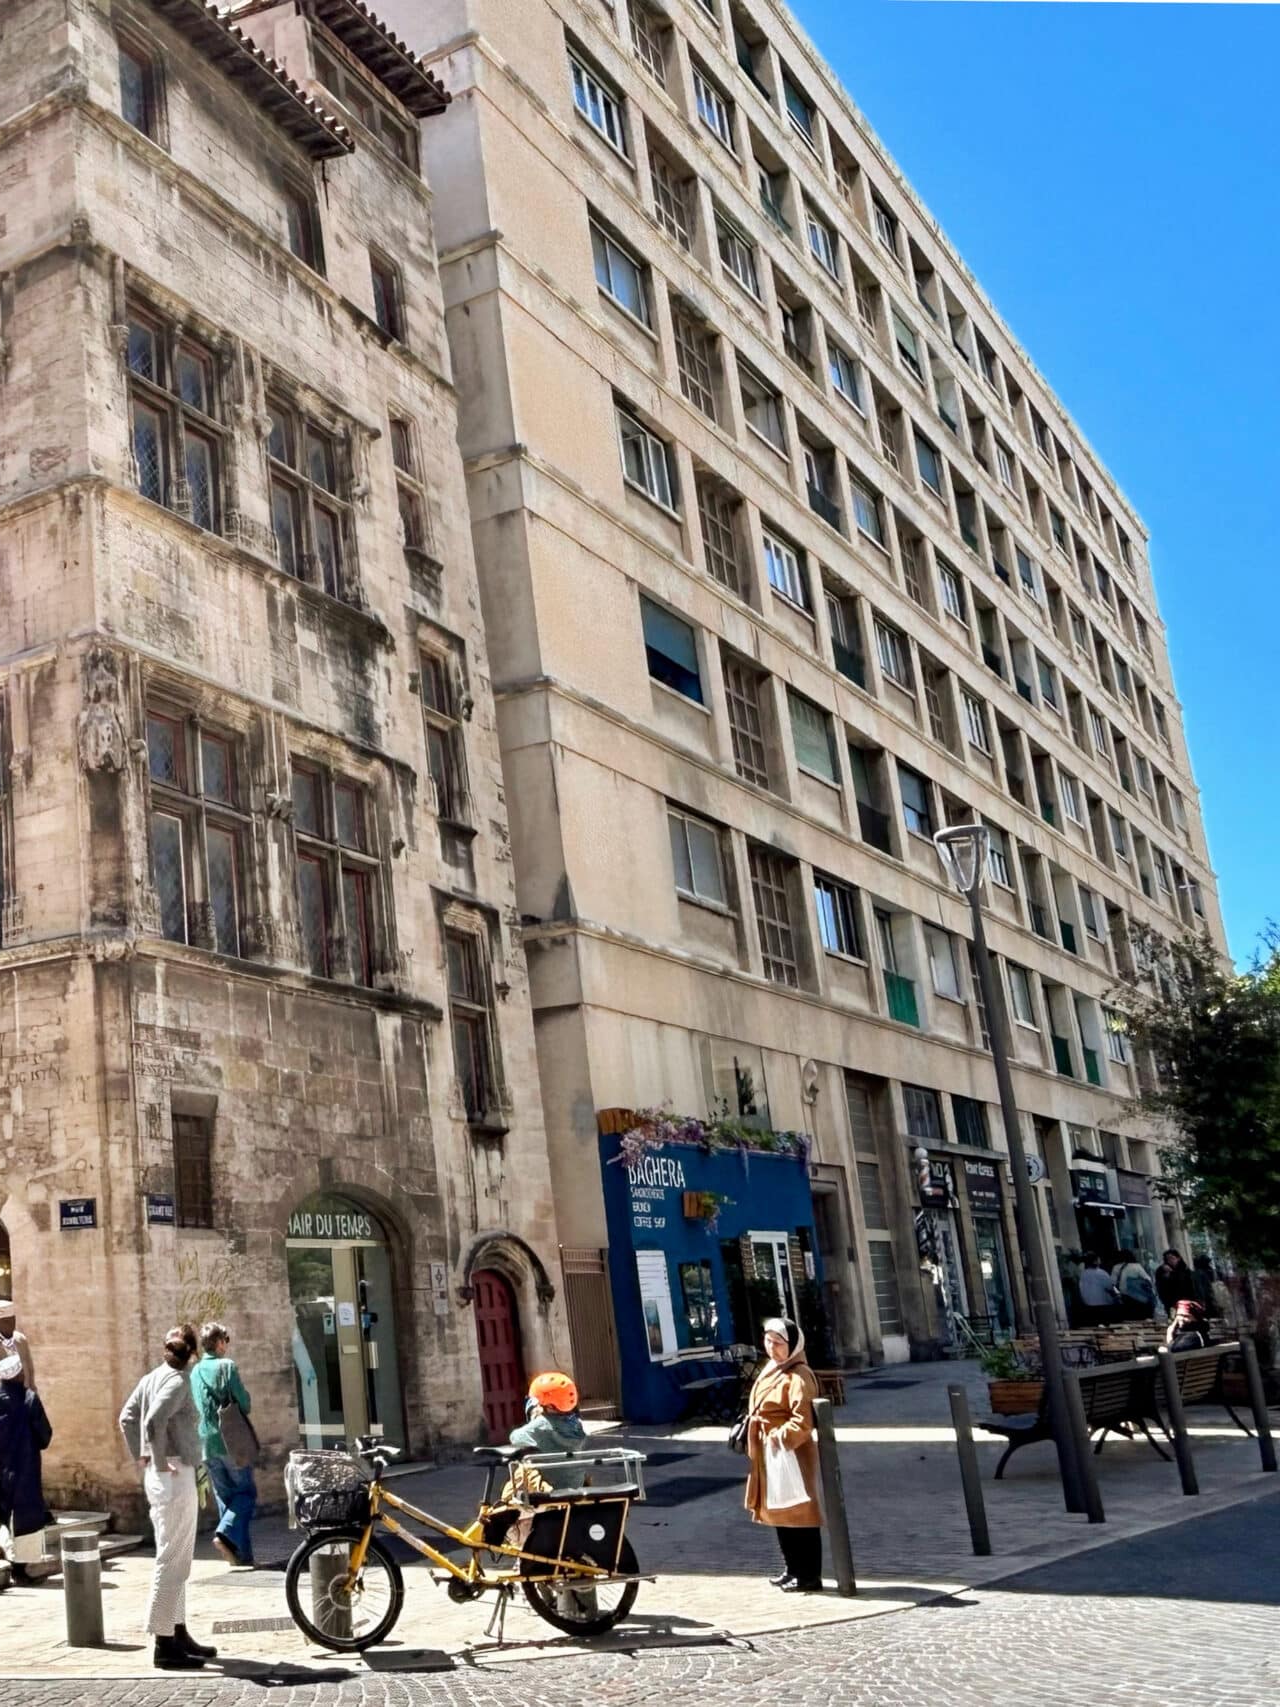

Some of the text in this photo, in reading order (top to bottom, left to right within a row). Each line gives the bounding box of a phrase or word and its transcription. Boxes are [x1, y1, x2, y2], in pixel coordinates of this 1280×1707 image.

[628, 1156, 686, 1188] BAGHERA
[315, 1214, 333, 1236] DU
[335, 1213, 371, 1236] TEMPS
